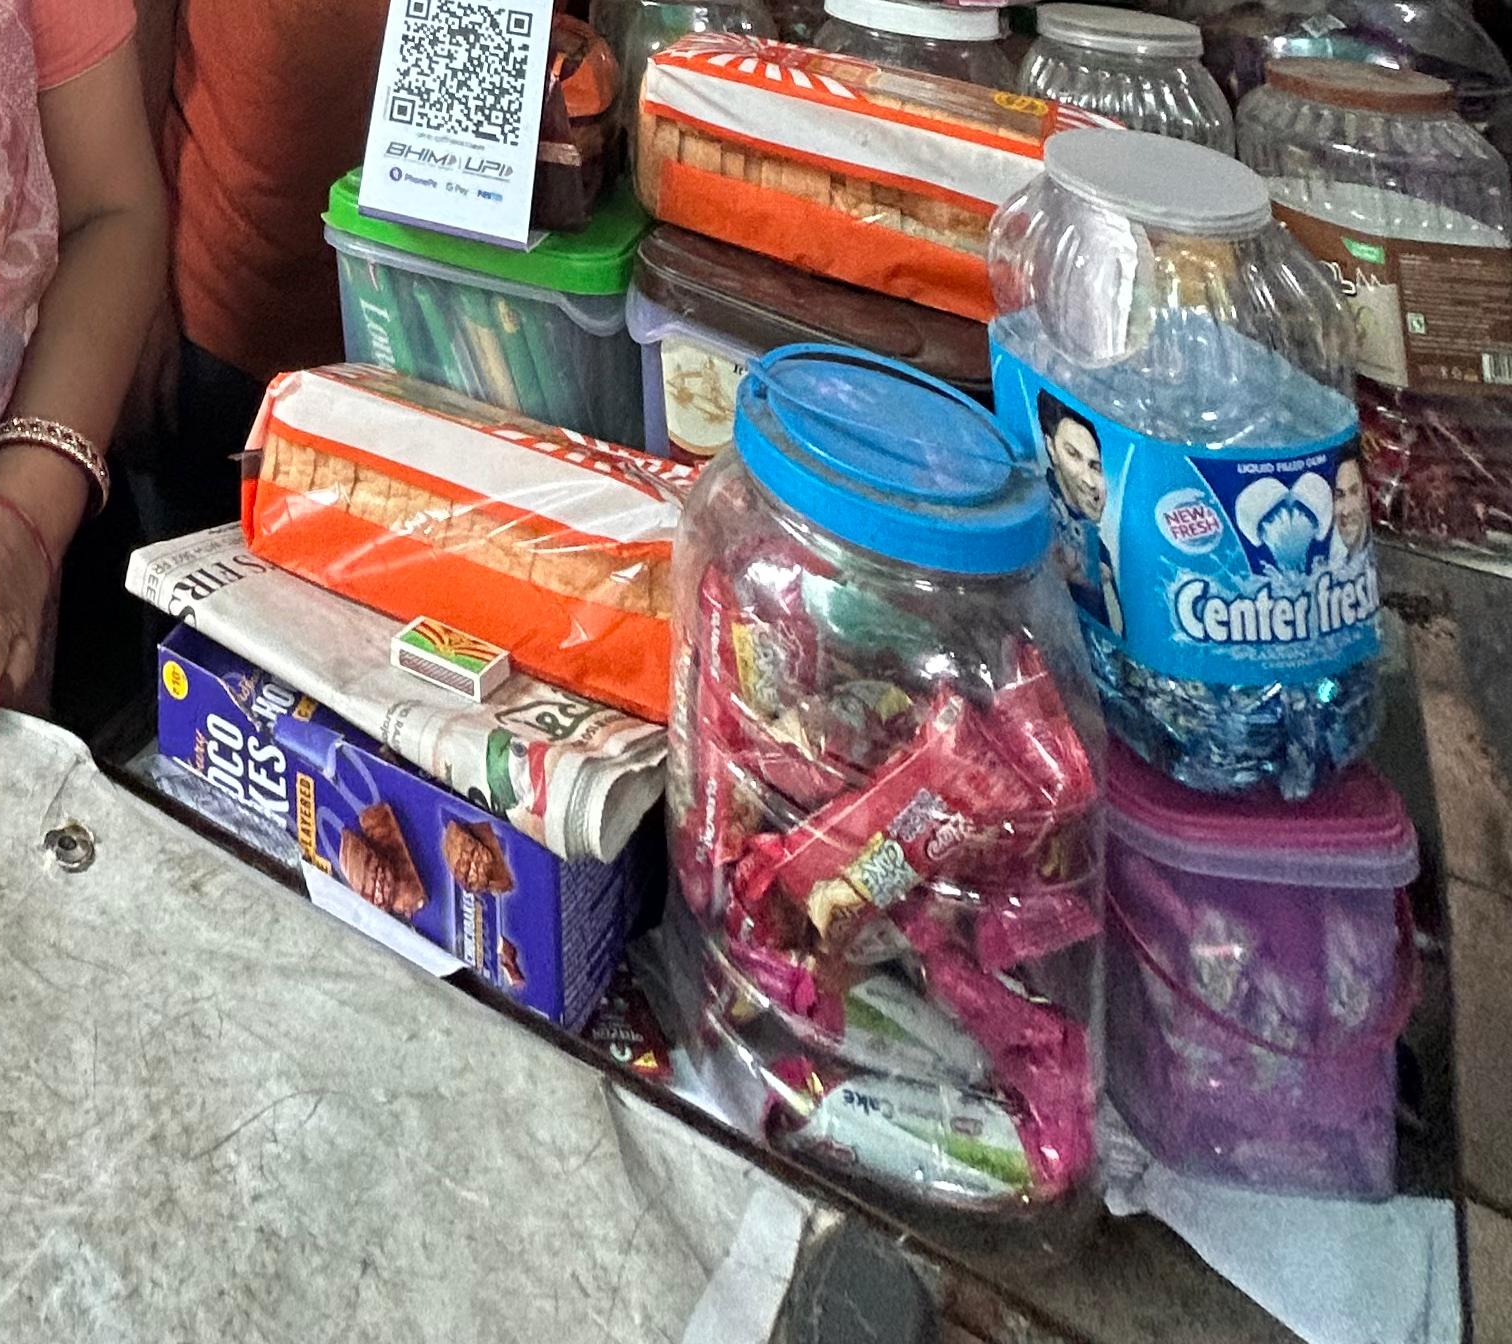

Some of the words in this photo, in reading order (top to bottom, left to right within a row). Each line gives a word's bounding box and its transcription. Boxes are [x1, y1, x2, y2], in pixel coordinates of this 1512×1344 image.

[385, 141, 450, 168] BHIM
[462, 156, 506, 180] UPI
[403, 172, 439, 190] PhonePe
[1237, 462, 1275, 474] LIQUID
[1163, 506, 1206, 526] NEW
[1170, 517, 1221, 540] FRESH
[1175, 578, 1311, 643] Center
